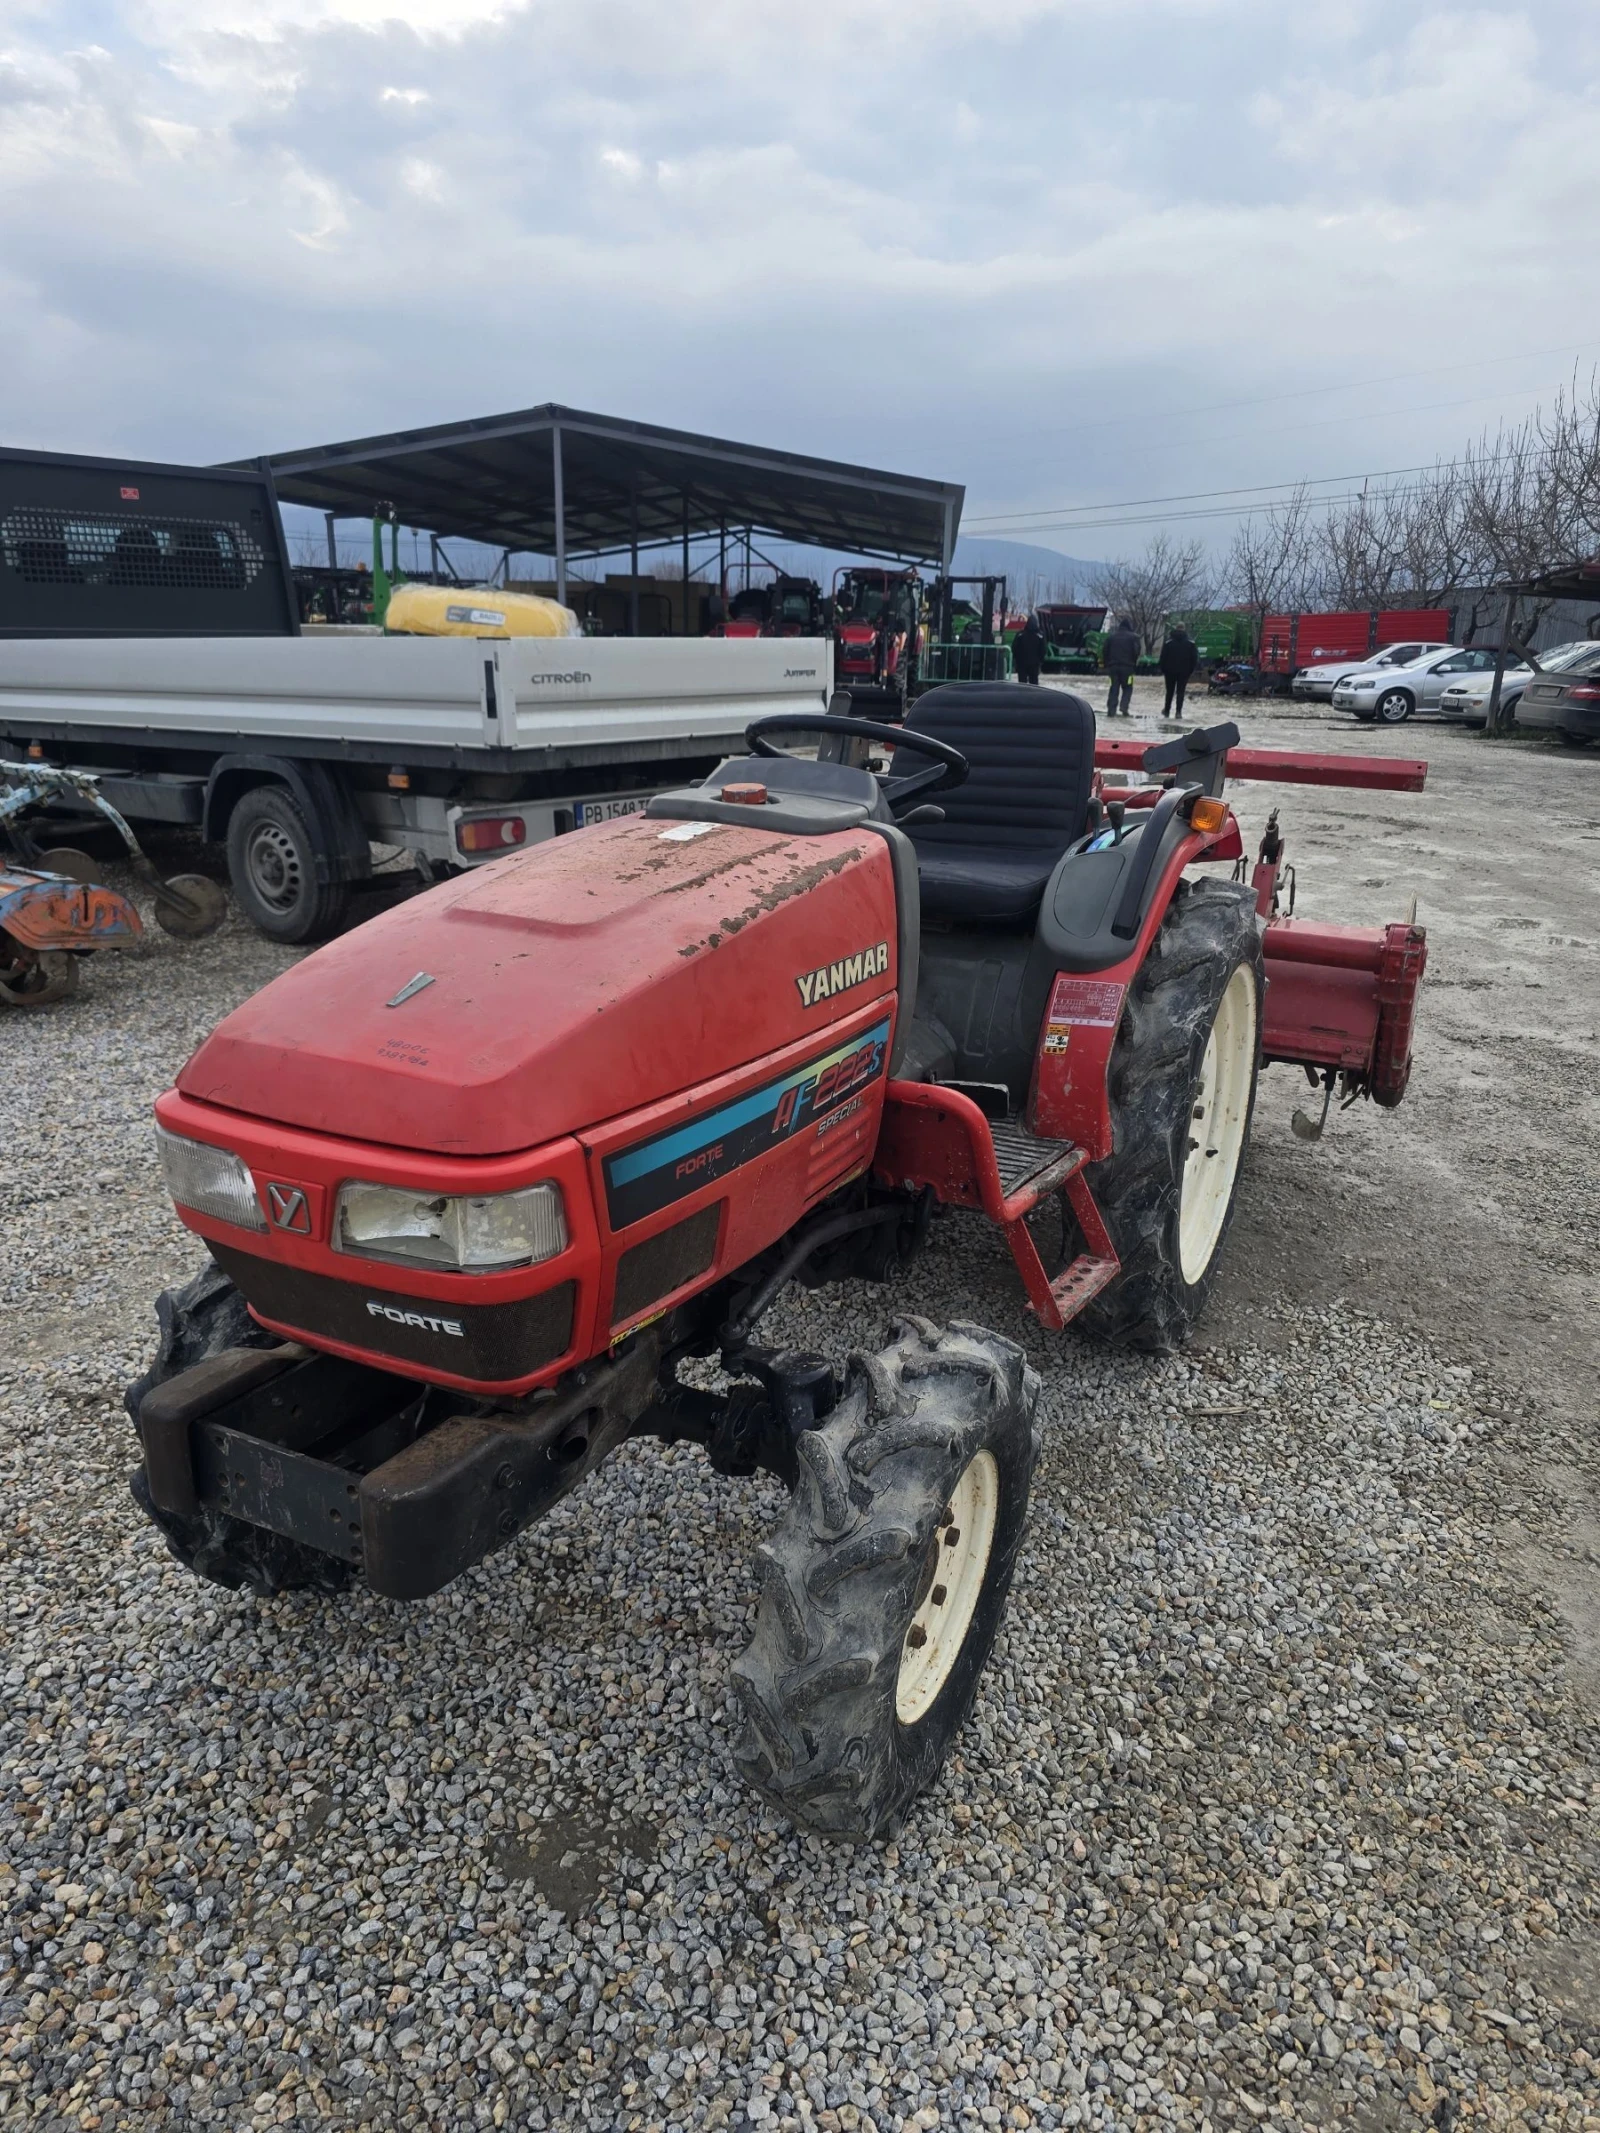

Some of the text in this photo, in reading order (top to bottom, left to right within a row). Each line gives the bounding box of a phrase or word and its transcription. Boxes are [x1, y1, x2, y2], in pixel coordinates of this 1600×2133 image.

[585, 798, 650, 825] PB 1548 T
[795, 941, 890, 1008] YANMAR
[817, 1095, 865, 1137] SPECIAL
[675, 1143, 724, 1180] FORTE
[366, 1301, 465, 1337] FORTE
